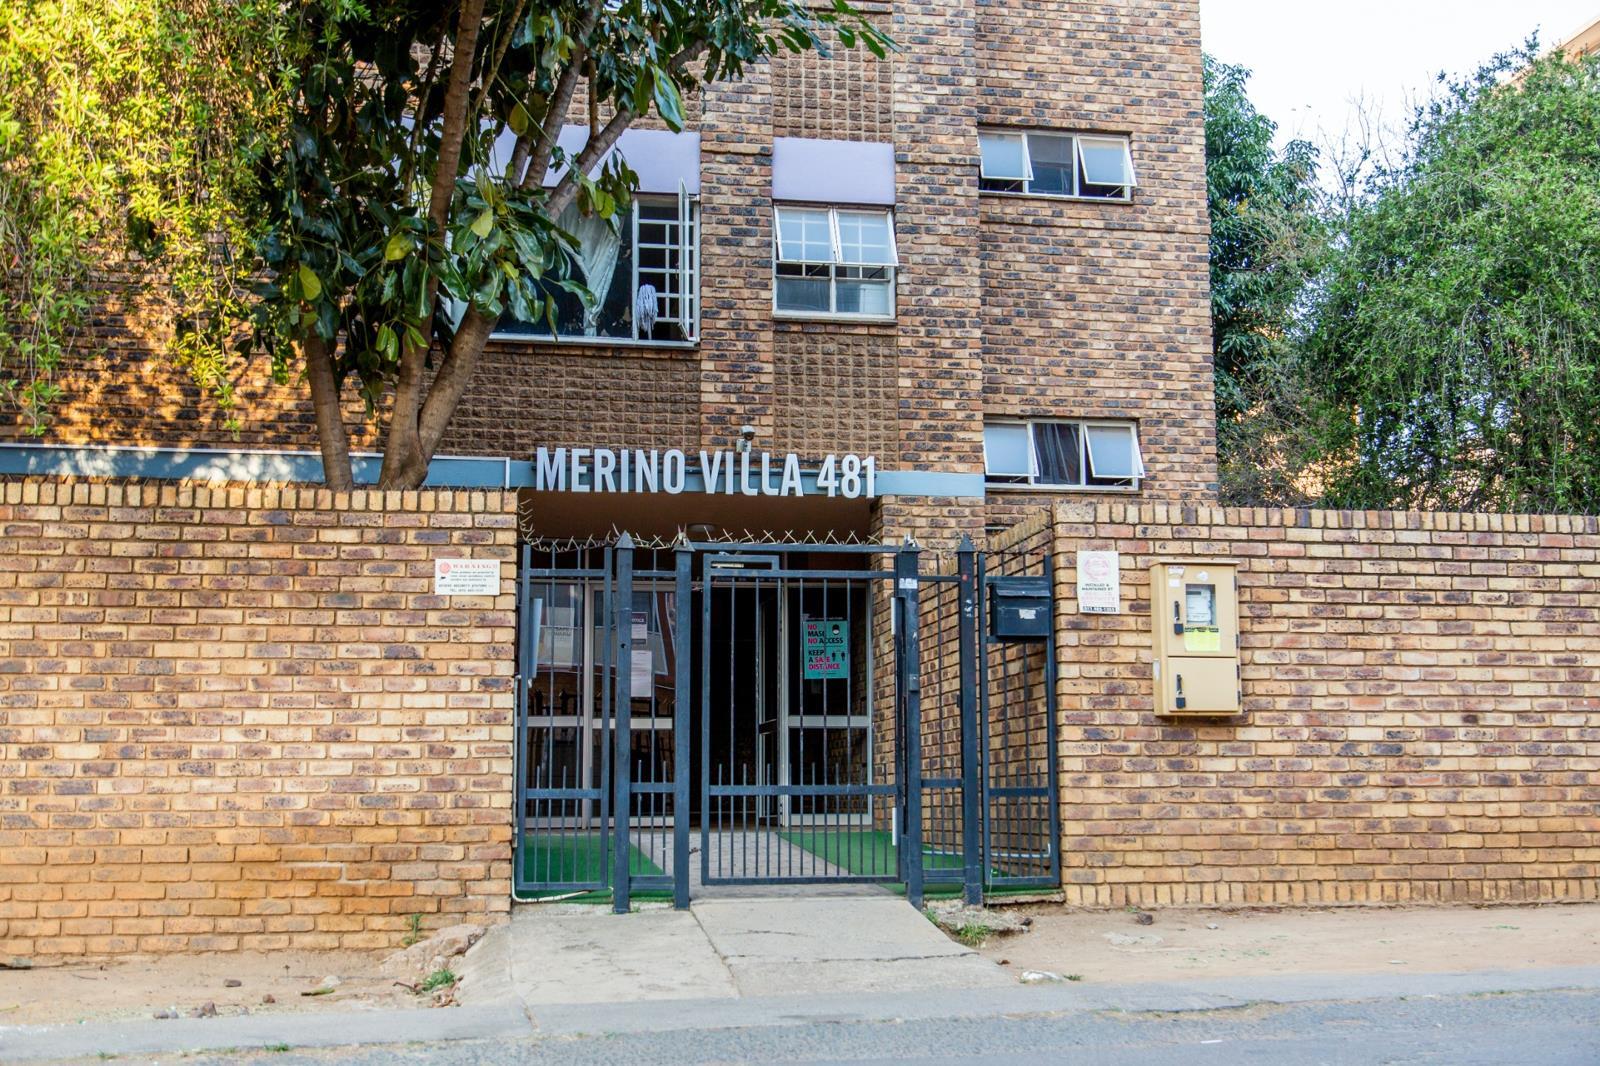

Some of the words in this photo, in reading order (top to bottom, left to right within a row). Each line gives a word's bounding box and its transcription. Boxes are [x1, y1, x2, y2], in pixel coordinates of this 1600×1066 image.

[536, 447, 686, 495] MERINO
[700, 450, 803, 497] VILLA
[817, 454, 875, 499] 481
